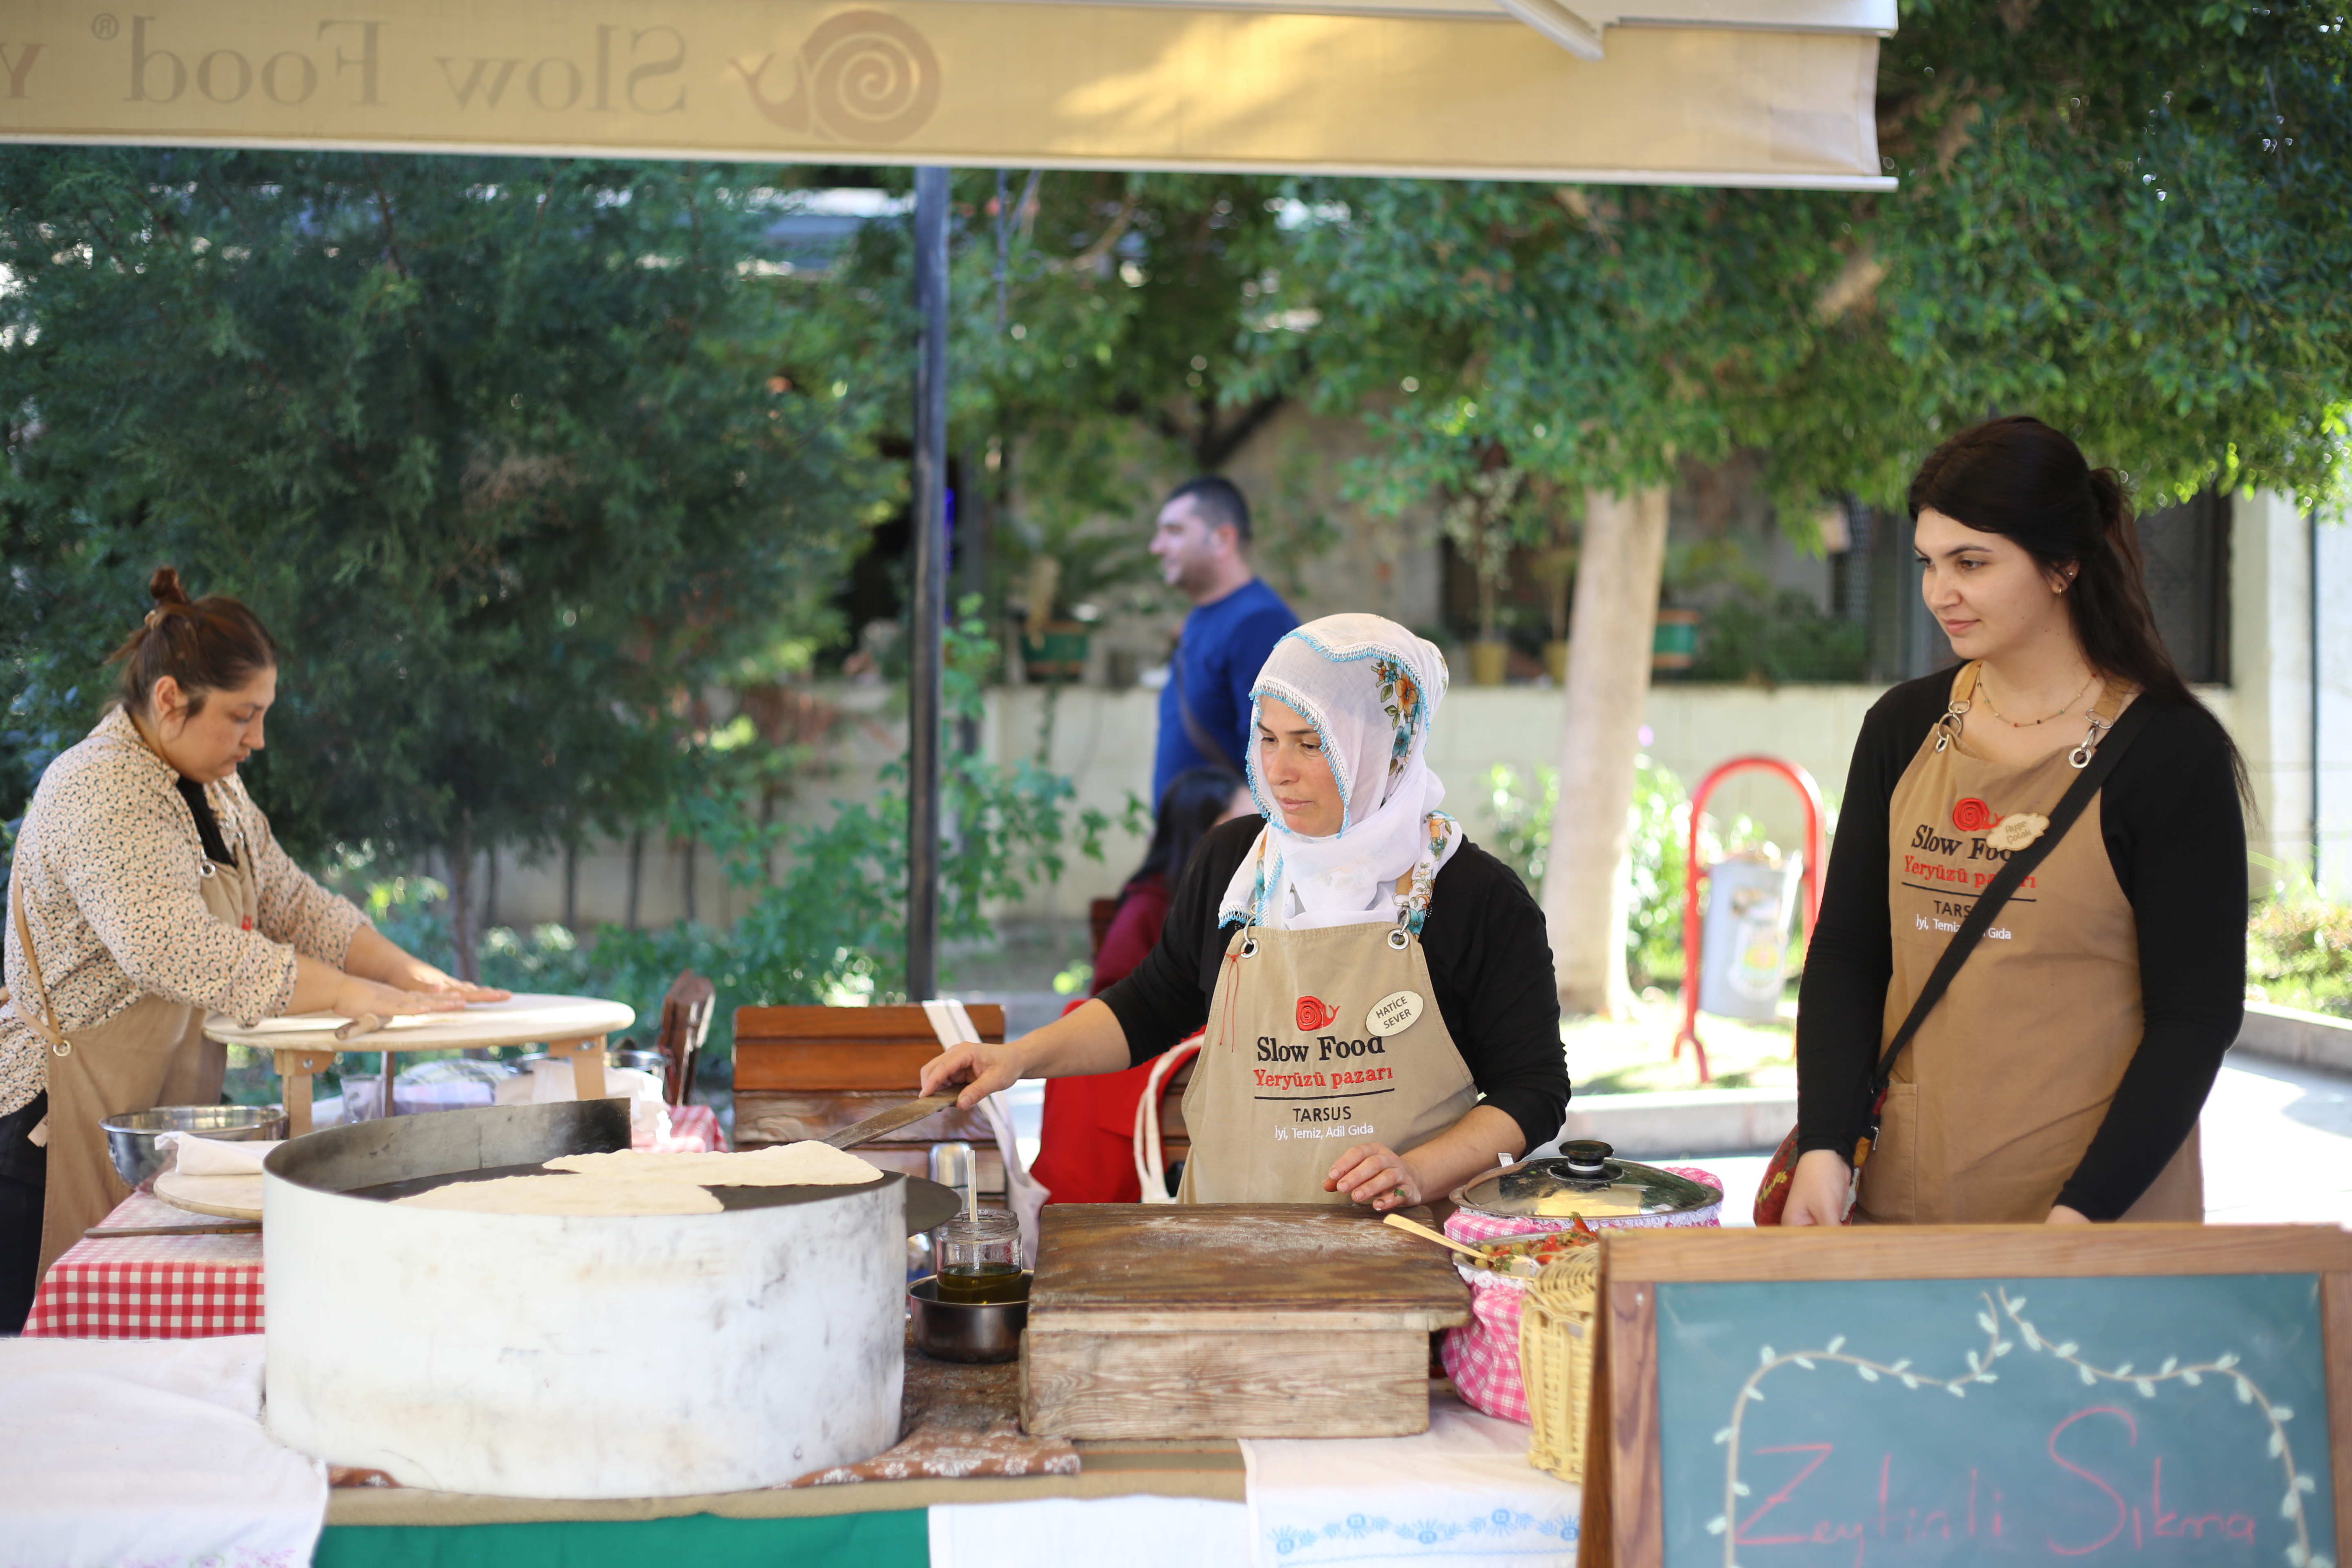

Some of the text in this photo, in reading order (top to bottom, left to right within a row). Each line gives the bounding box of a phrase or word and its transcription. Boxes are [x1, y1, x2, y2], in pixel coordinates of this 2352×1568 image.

[1911, 824, 2016, 862] Slow Foo
[1904, 855, 2036, 888] Yeryüzü parı
[1933, 900, 1971, 918] TARS
[1376, 996, 1408, 1018] HATİCE
[1383, 1009, 1411, 1029] SEVER
[1257, 1036, 1385, 1062] Slow Food
[1253, 1067, 1393, 1090] Yeryüzü pazarı
[1293, 1106, 1351, 1122] TARSUS
[1292, 1127, 1323, 1140] Temiz,
[1325, 1125, 1345, 1138] Adil
[1348, 1123, 1374, 1135] Gıda
[1734, 1443, 2002, 1568] Zeytinli
